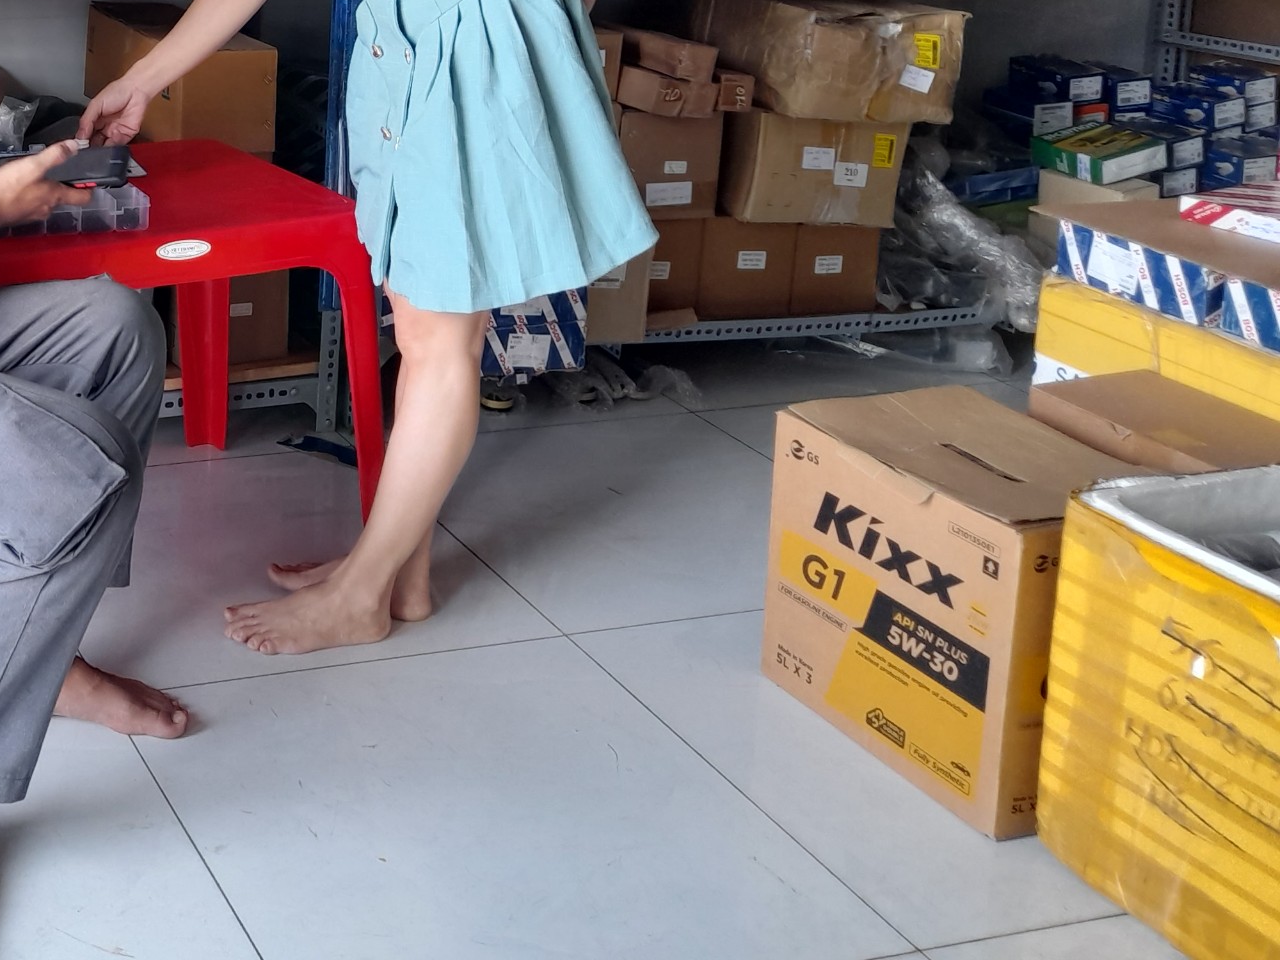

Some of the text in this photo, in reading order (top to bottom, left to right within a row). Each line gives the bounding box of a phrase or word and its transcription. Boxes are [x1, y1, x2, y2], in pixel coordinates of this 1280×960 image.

[844, 167, 858, 177] 210
[1174, 273, 1189, 306] BOSCH
[807, 452, 820, 466] GS
[814, 491, 965, 610] Kixx
[802, 554, 846, 600] G1
[781, 585, 844, 629] FOR GASOLINE ENGINE
[887, 624, 959, 682] 5W-30
[893, 612, 968, 665] API SN PLUS
[776, 652, 812, 684] 5L X 3
[880, 666, 909, 687] protection
[913, 748, 966, 789] Fully Synthetic
[1011, 804, 1024, 814] 5L
